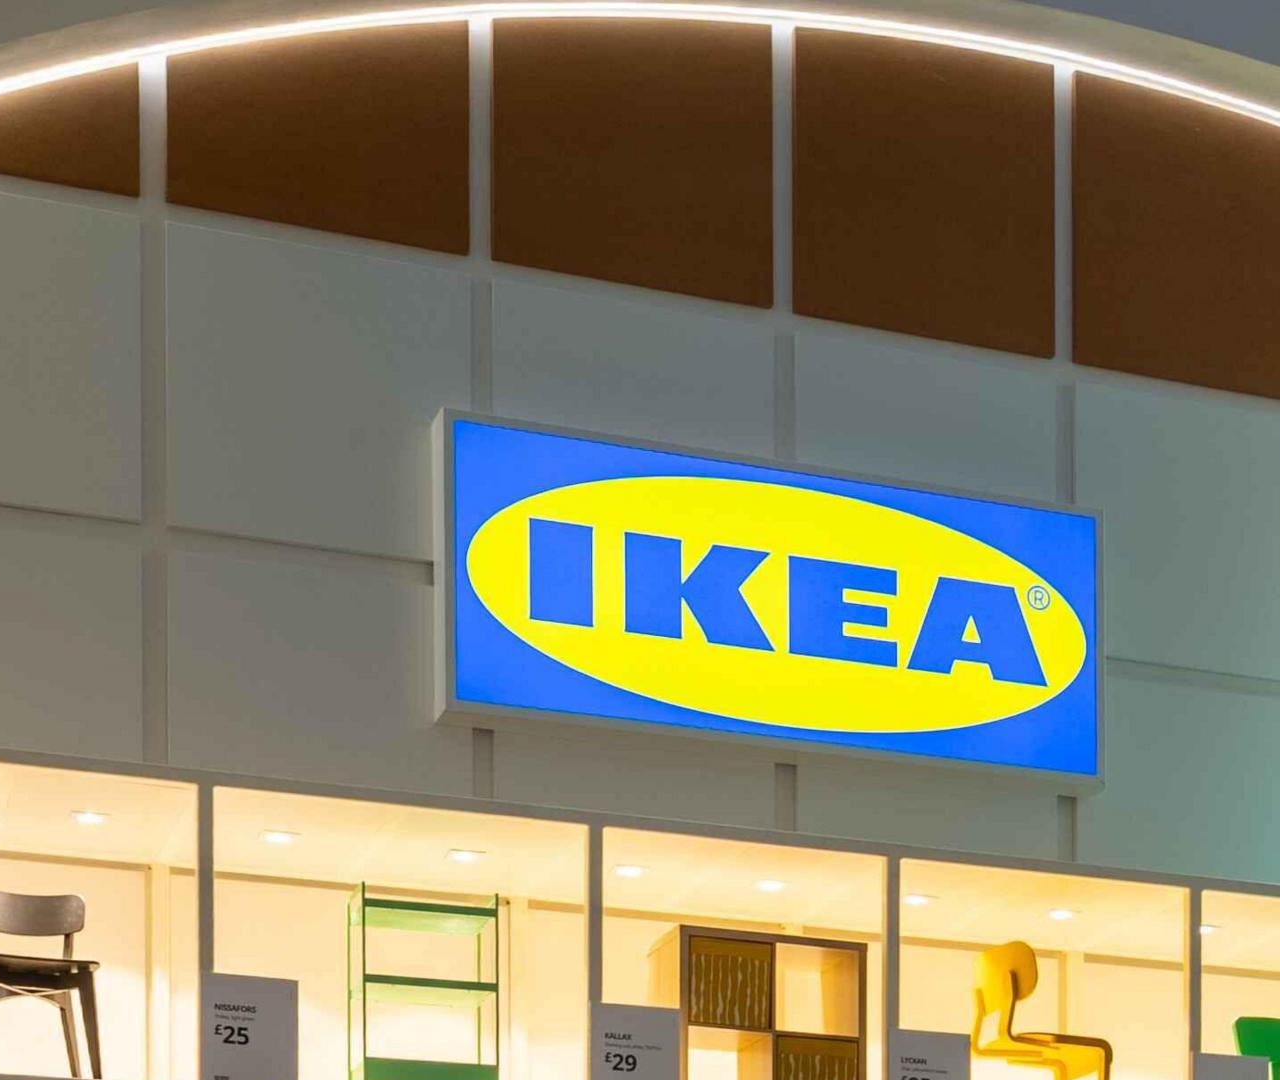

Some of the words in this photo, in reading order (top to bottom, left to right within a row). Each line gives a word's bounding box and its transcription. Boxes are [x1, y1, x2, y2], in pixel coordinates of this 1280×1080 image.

[528, 517, 1049, 687] IKEA
[214, 1023, 250, 1045] £25
[604, 1051, 638, 1072] £29
